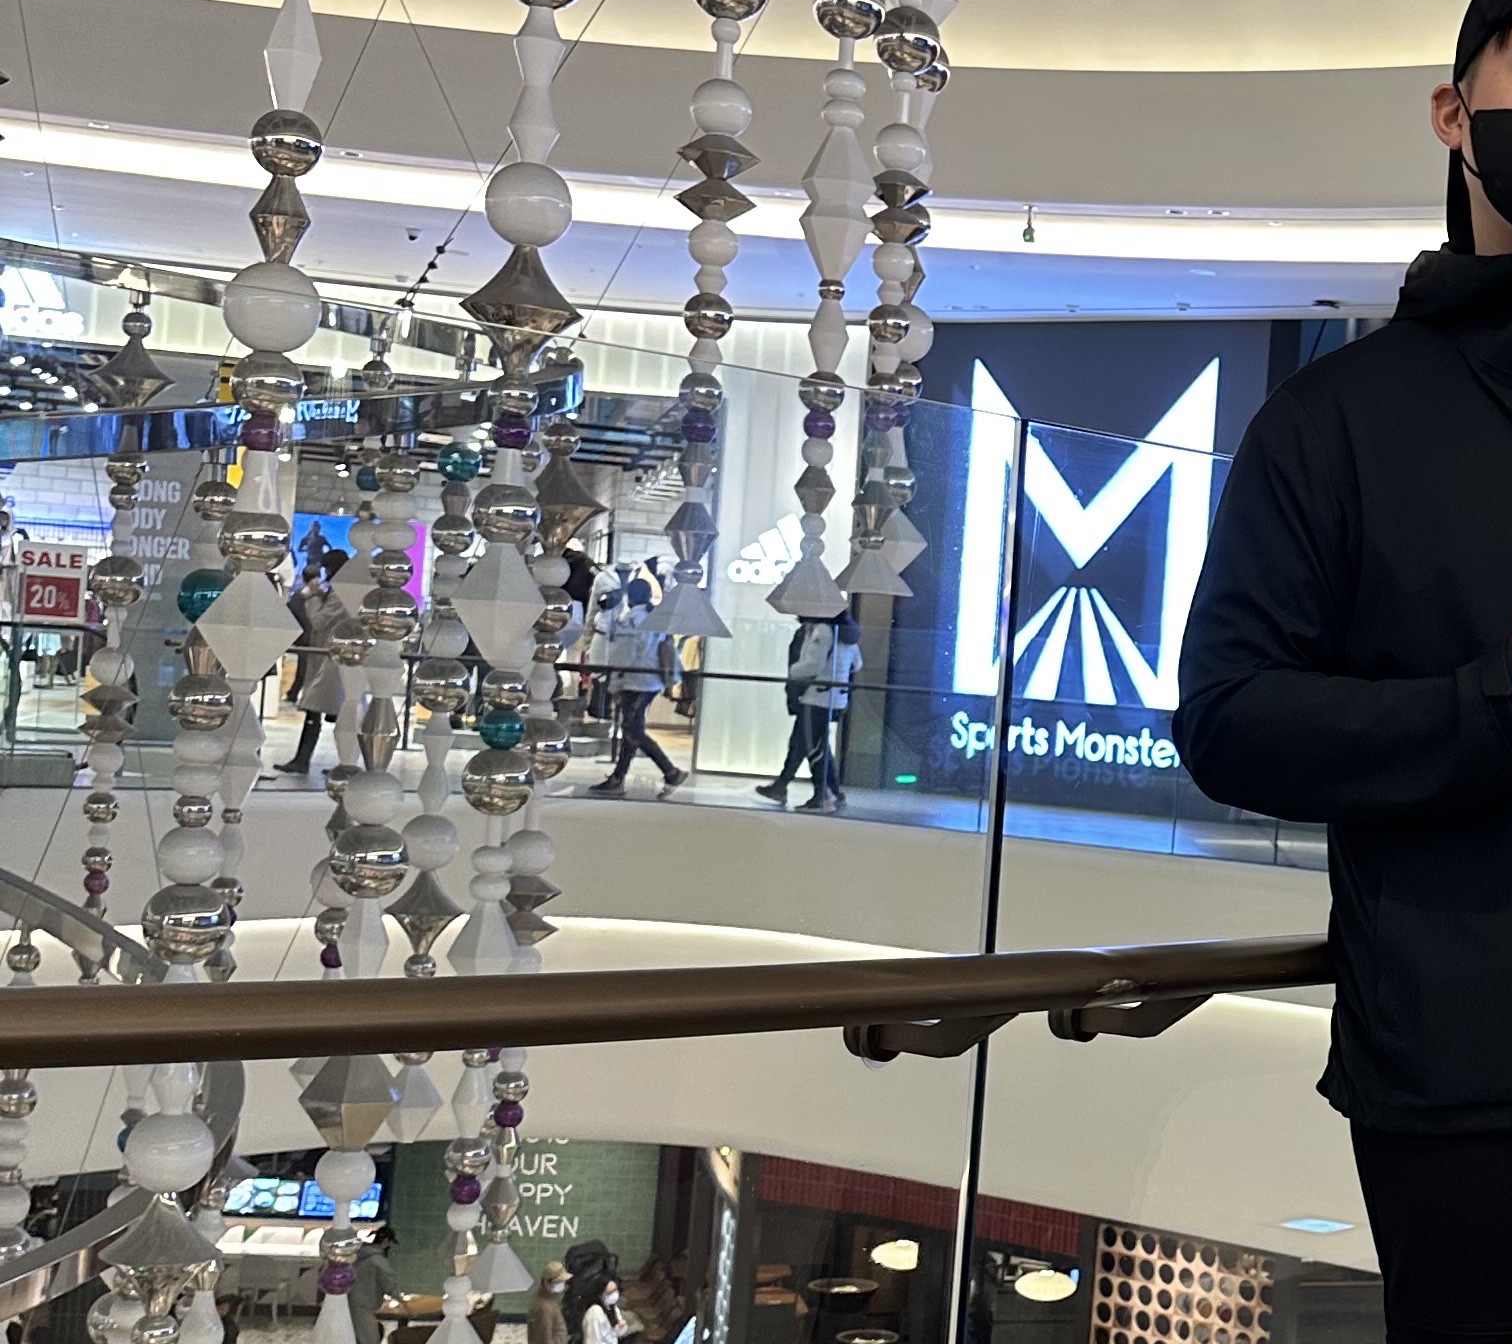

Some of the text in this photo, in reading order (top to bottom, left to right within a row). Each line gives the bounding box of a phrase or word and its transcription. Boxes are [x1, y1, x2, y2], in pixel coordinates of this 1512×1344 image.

[136, 479, 181, 503] ONG
[132, 507, 167, 530] DY
[21, 550, 83, 569] SALE
[511, 1153, 558, 1176] UR
[518, 1182, 573, 1205] PPY
[477, 1214, 579, 1238] HAVEN
